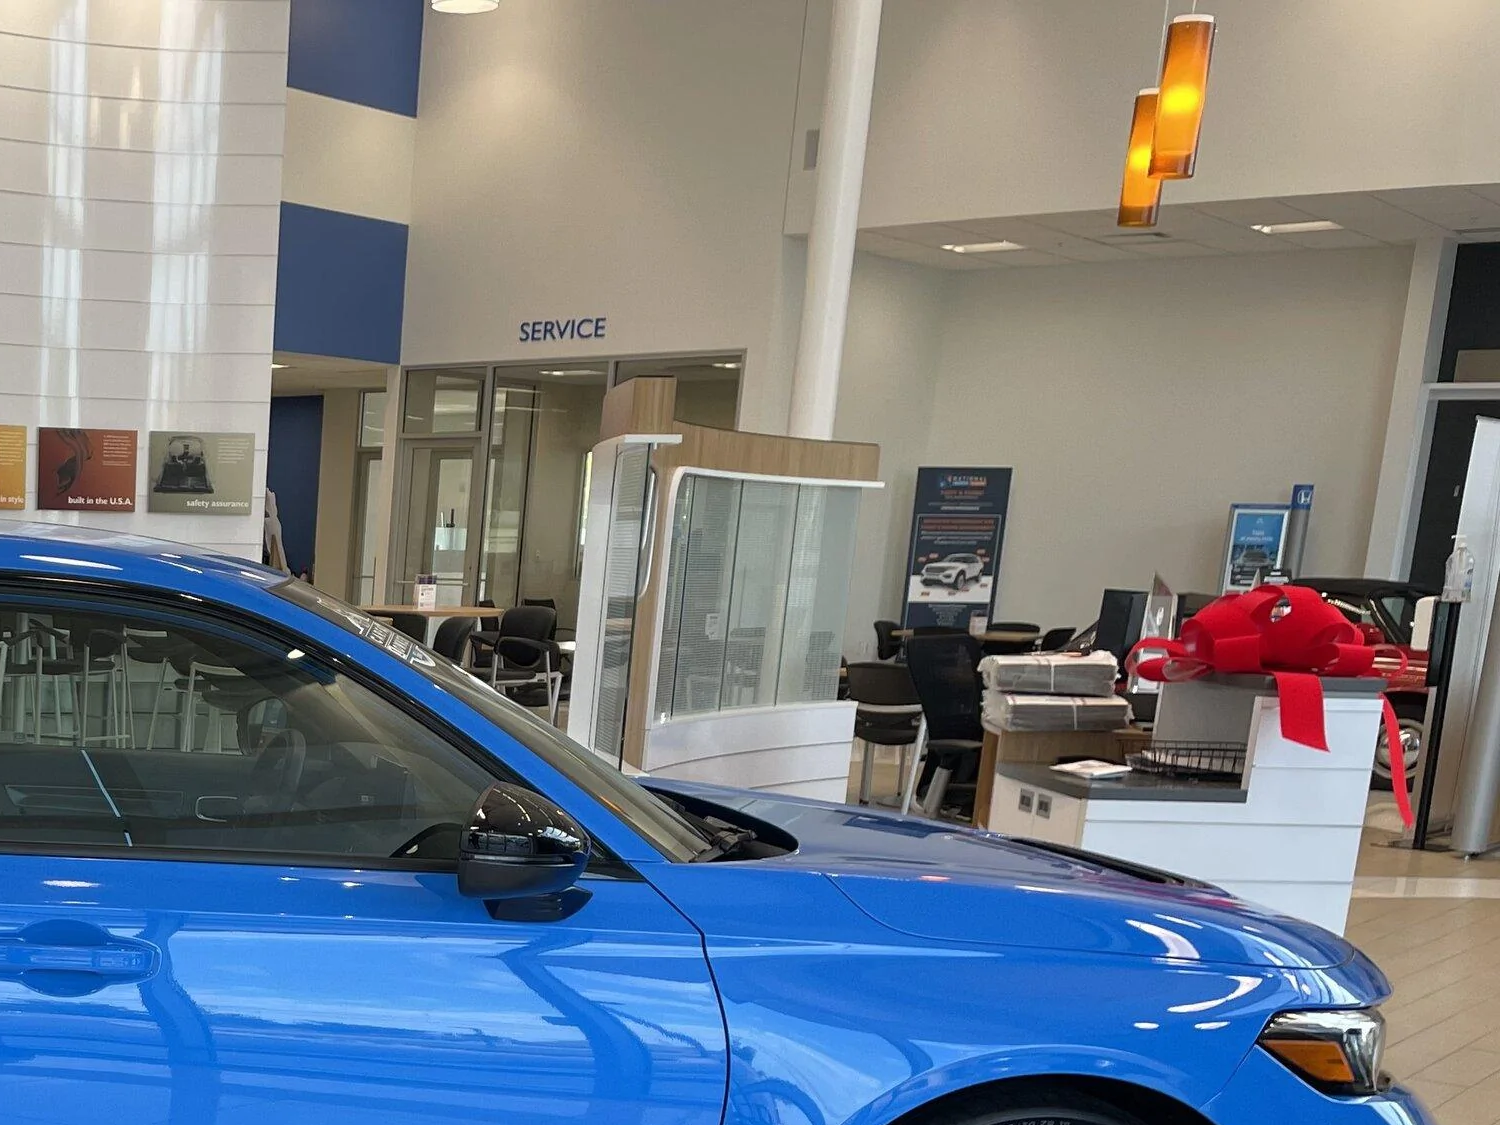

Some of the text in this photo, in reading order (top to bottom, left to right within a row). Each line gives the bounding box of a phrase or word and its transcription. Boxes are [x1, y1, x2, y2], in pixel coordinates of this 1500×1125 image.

[519, 317, 607, 342] SERVICE
[0, 494, 7, 503] in
[8, 495, 24, 505] style
[67, 495, 133, 506] built in the U.S.A.
[186, 499, 210, 509] safety
